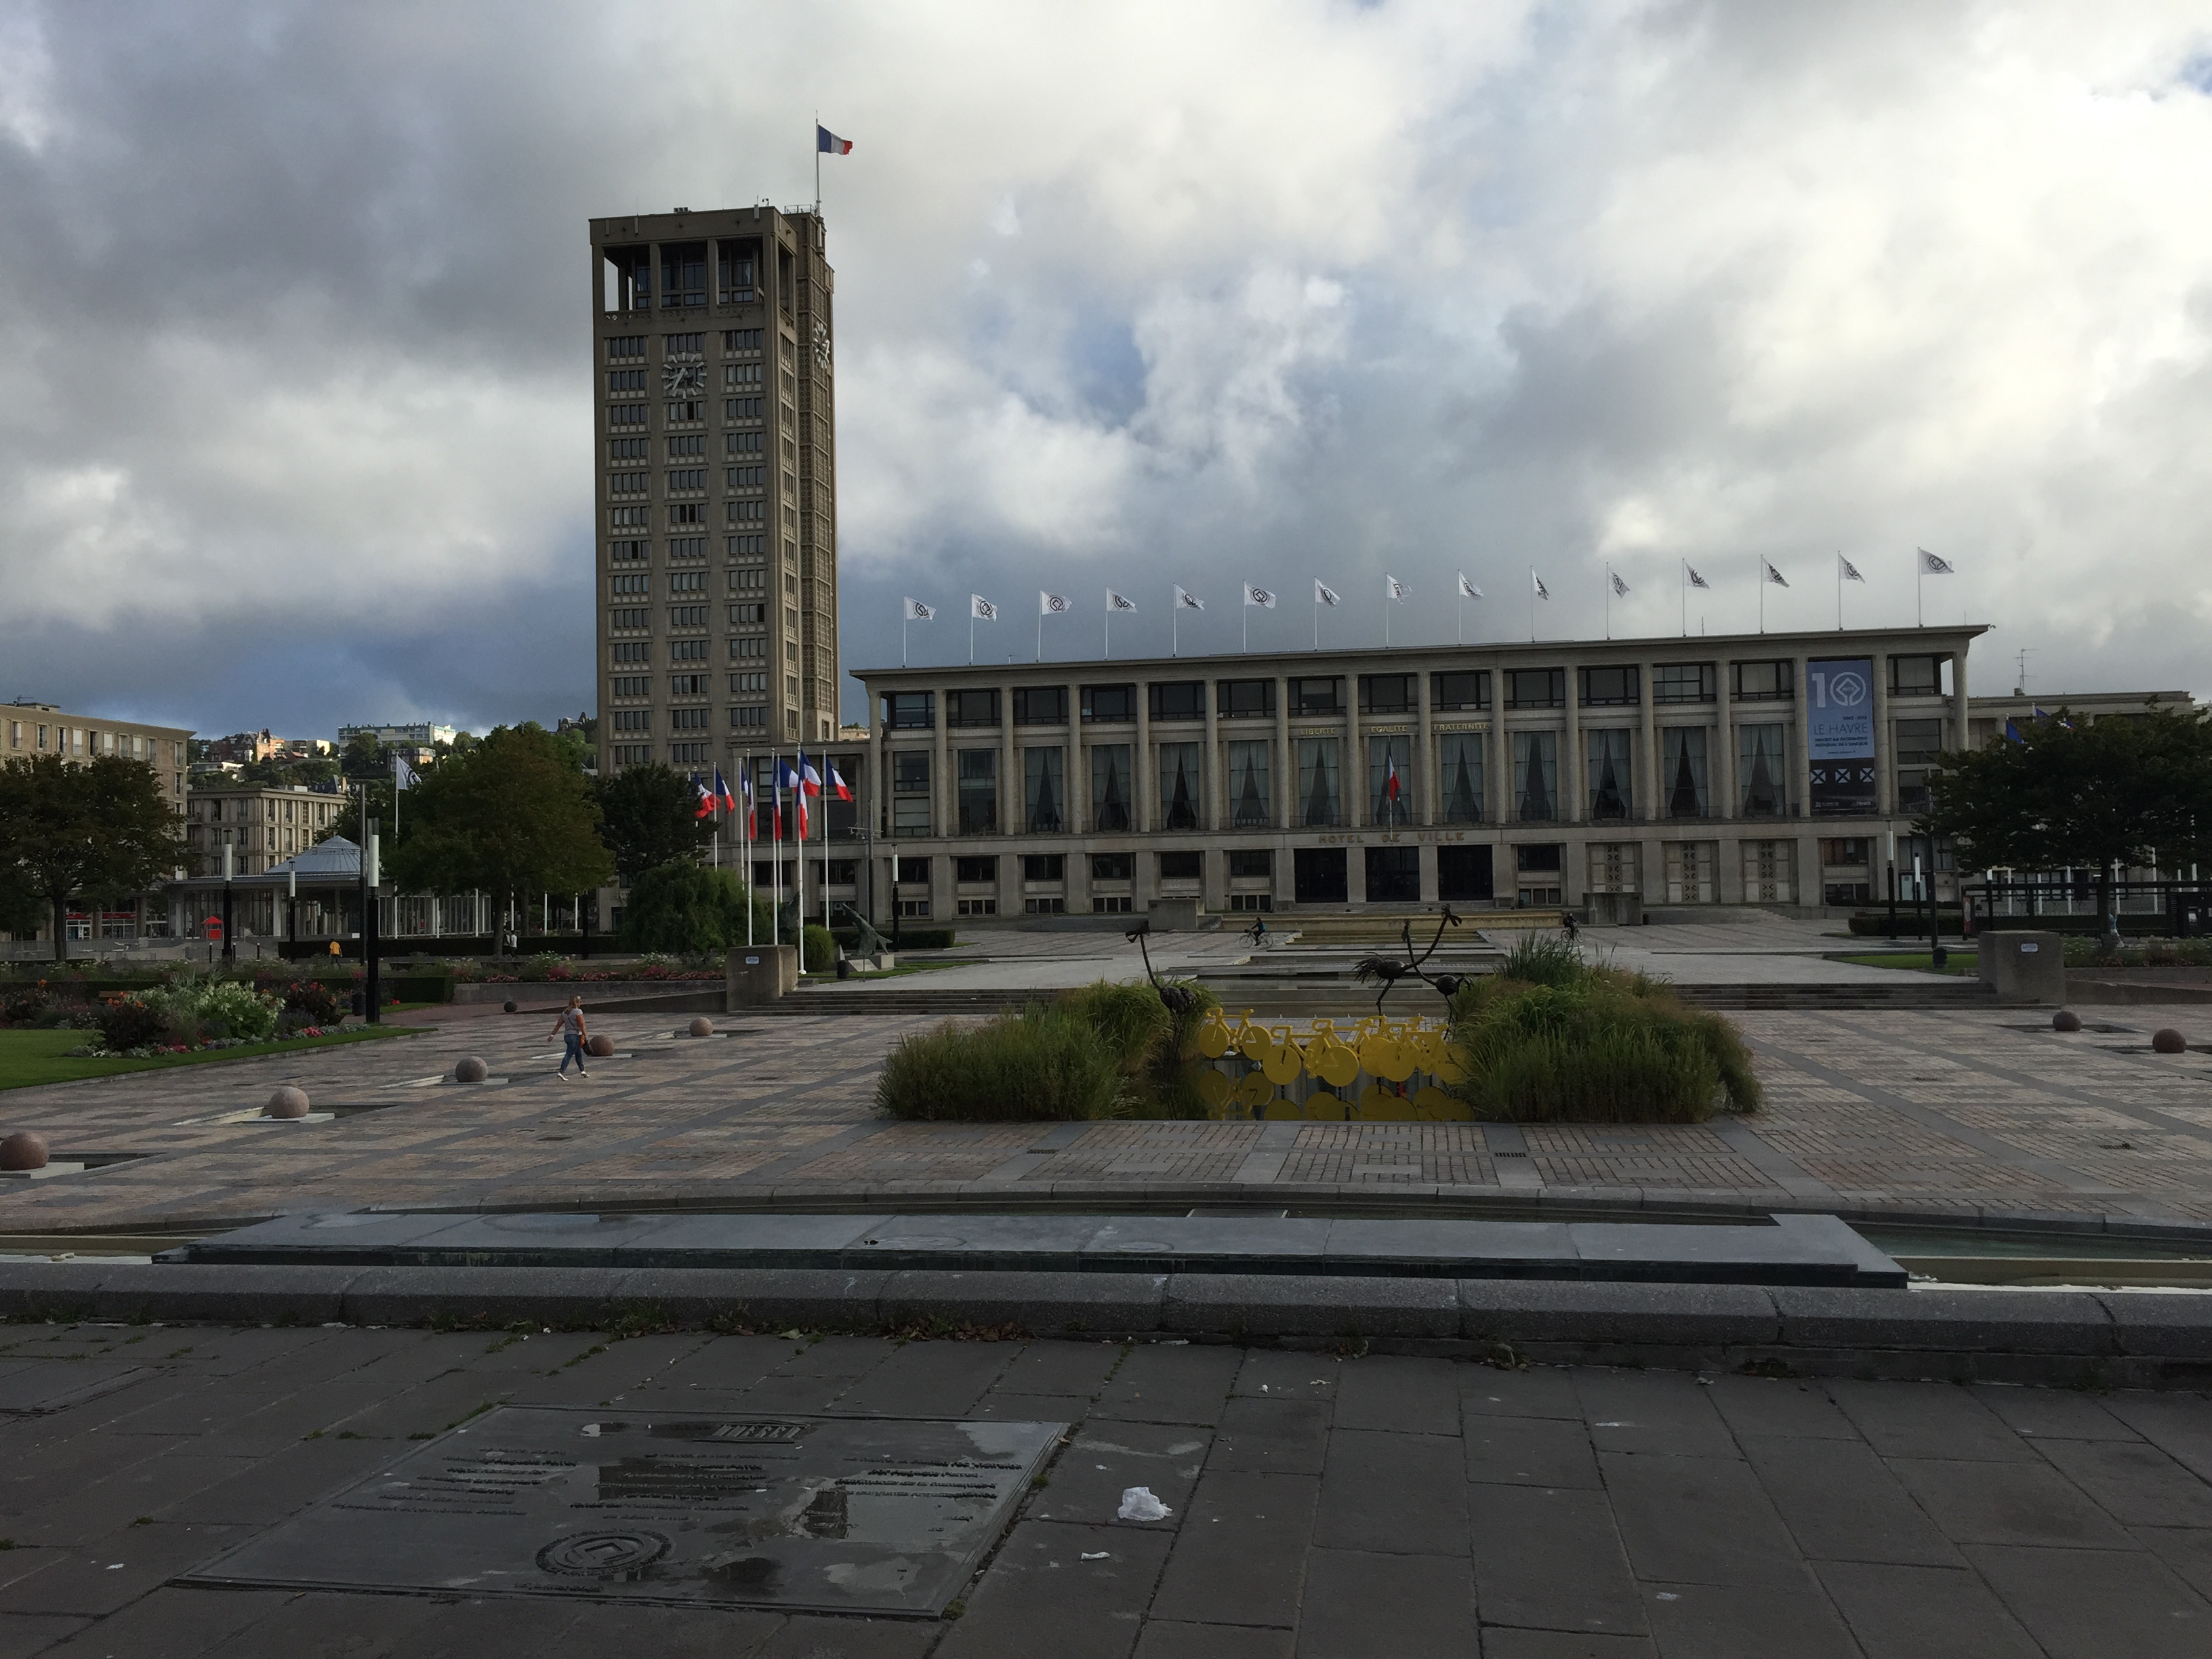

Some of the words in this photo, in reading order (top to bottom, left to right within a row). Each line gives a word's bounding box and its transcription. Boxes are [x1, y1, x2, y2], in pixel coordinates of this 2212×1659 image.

[1814, 724, 1825, 735] LE
[1829, 722, 1868, 734] HAVRE
[1381, 833, 1401, 842] DE
[1417, 832, 1465, 842] VILLE
